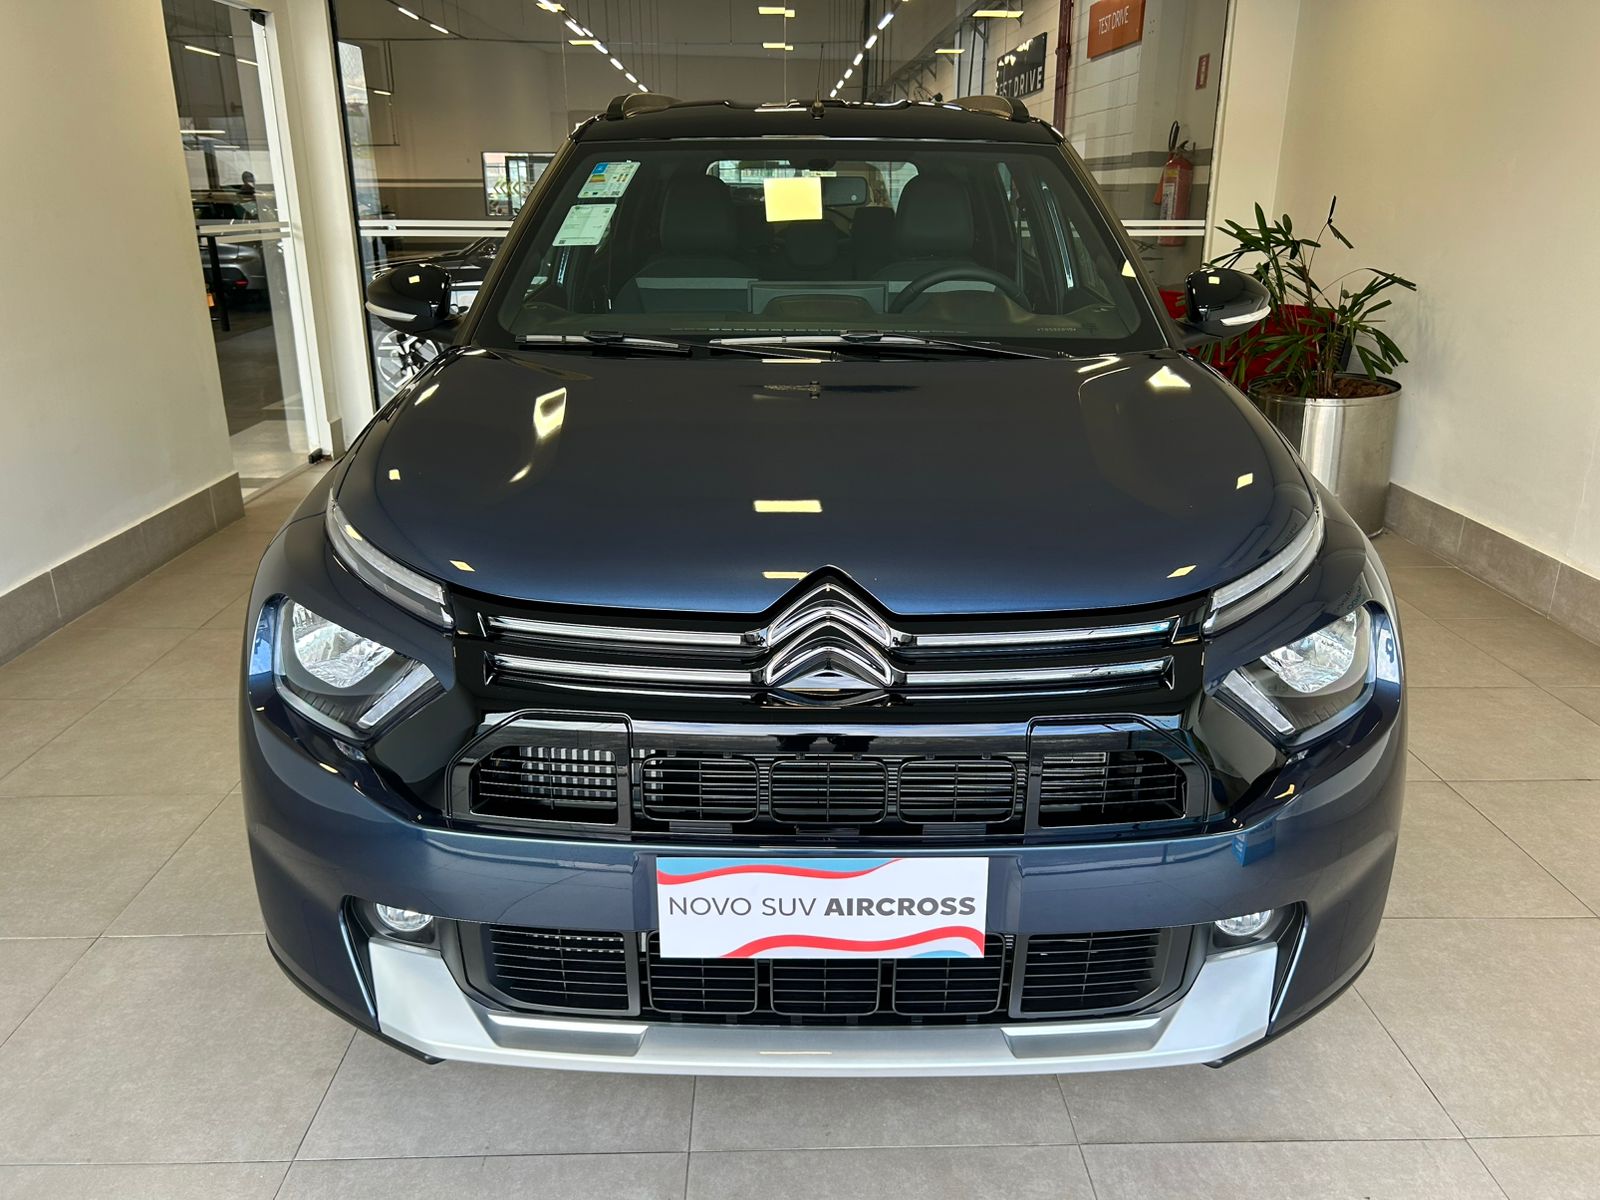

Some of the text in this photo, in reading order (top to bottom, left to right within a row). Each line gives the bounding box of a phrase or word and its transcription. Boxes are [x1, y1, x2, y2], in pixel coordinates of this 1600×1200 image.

[1098, 5, 1130, 35] TEST DRIVE
[1013, 65, 1043, 97] DRIVE
[669, 896, 976, 917] NOVO SUV AIRCROSS
